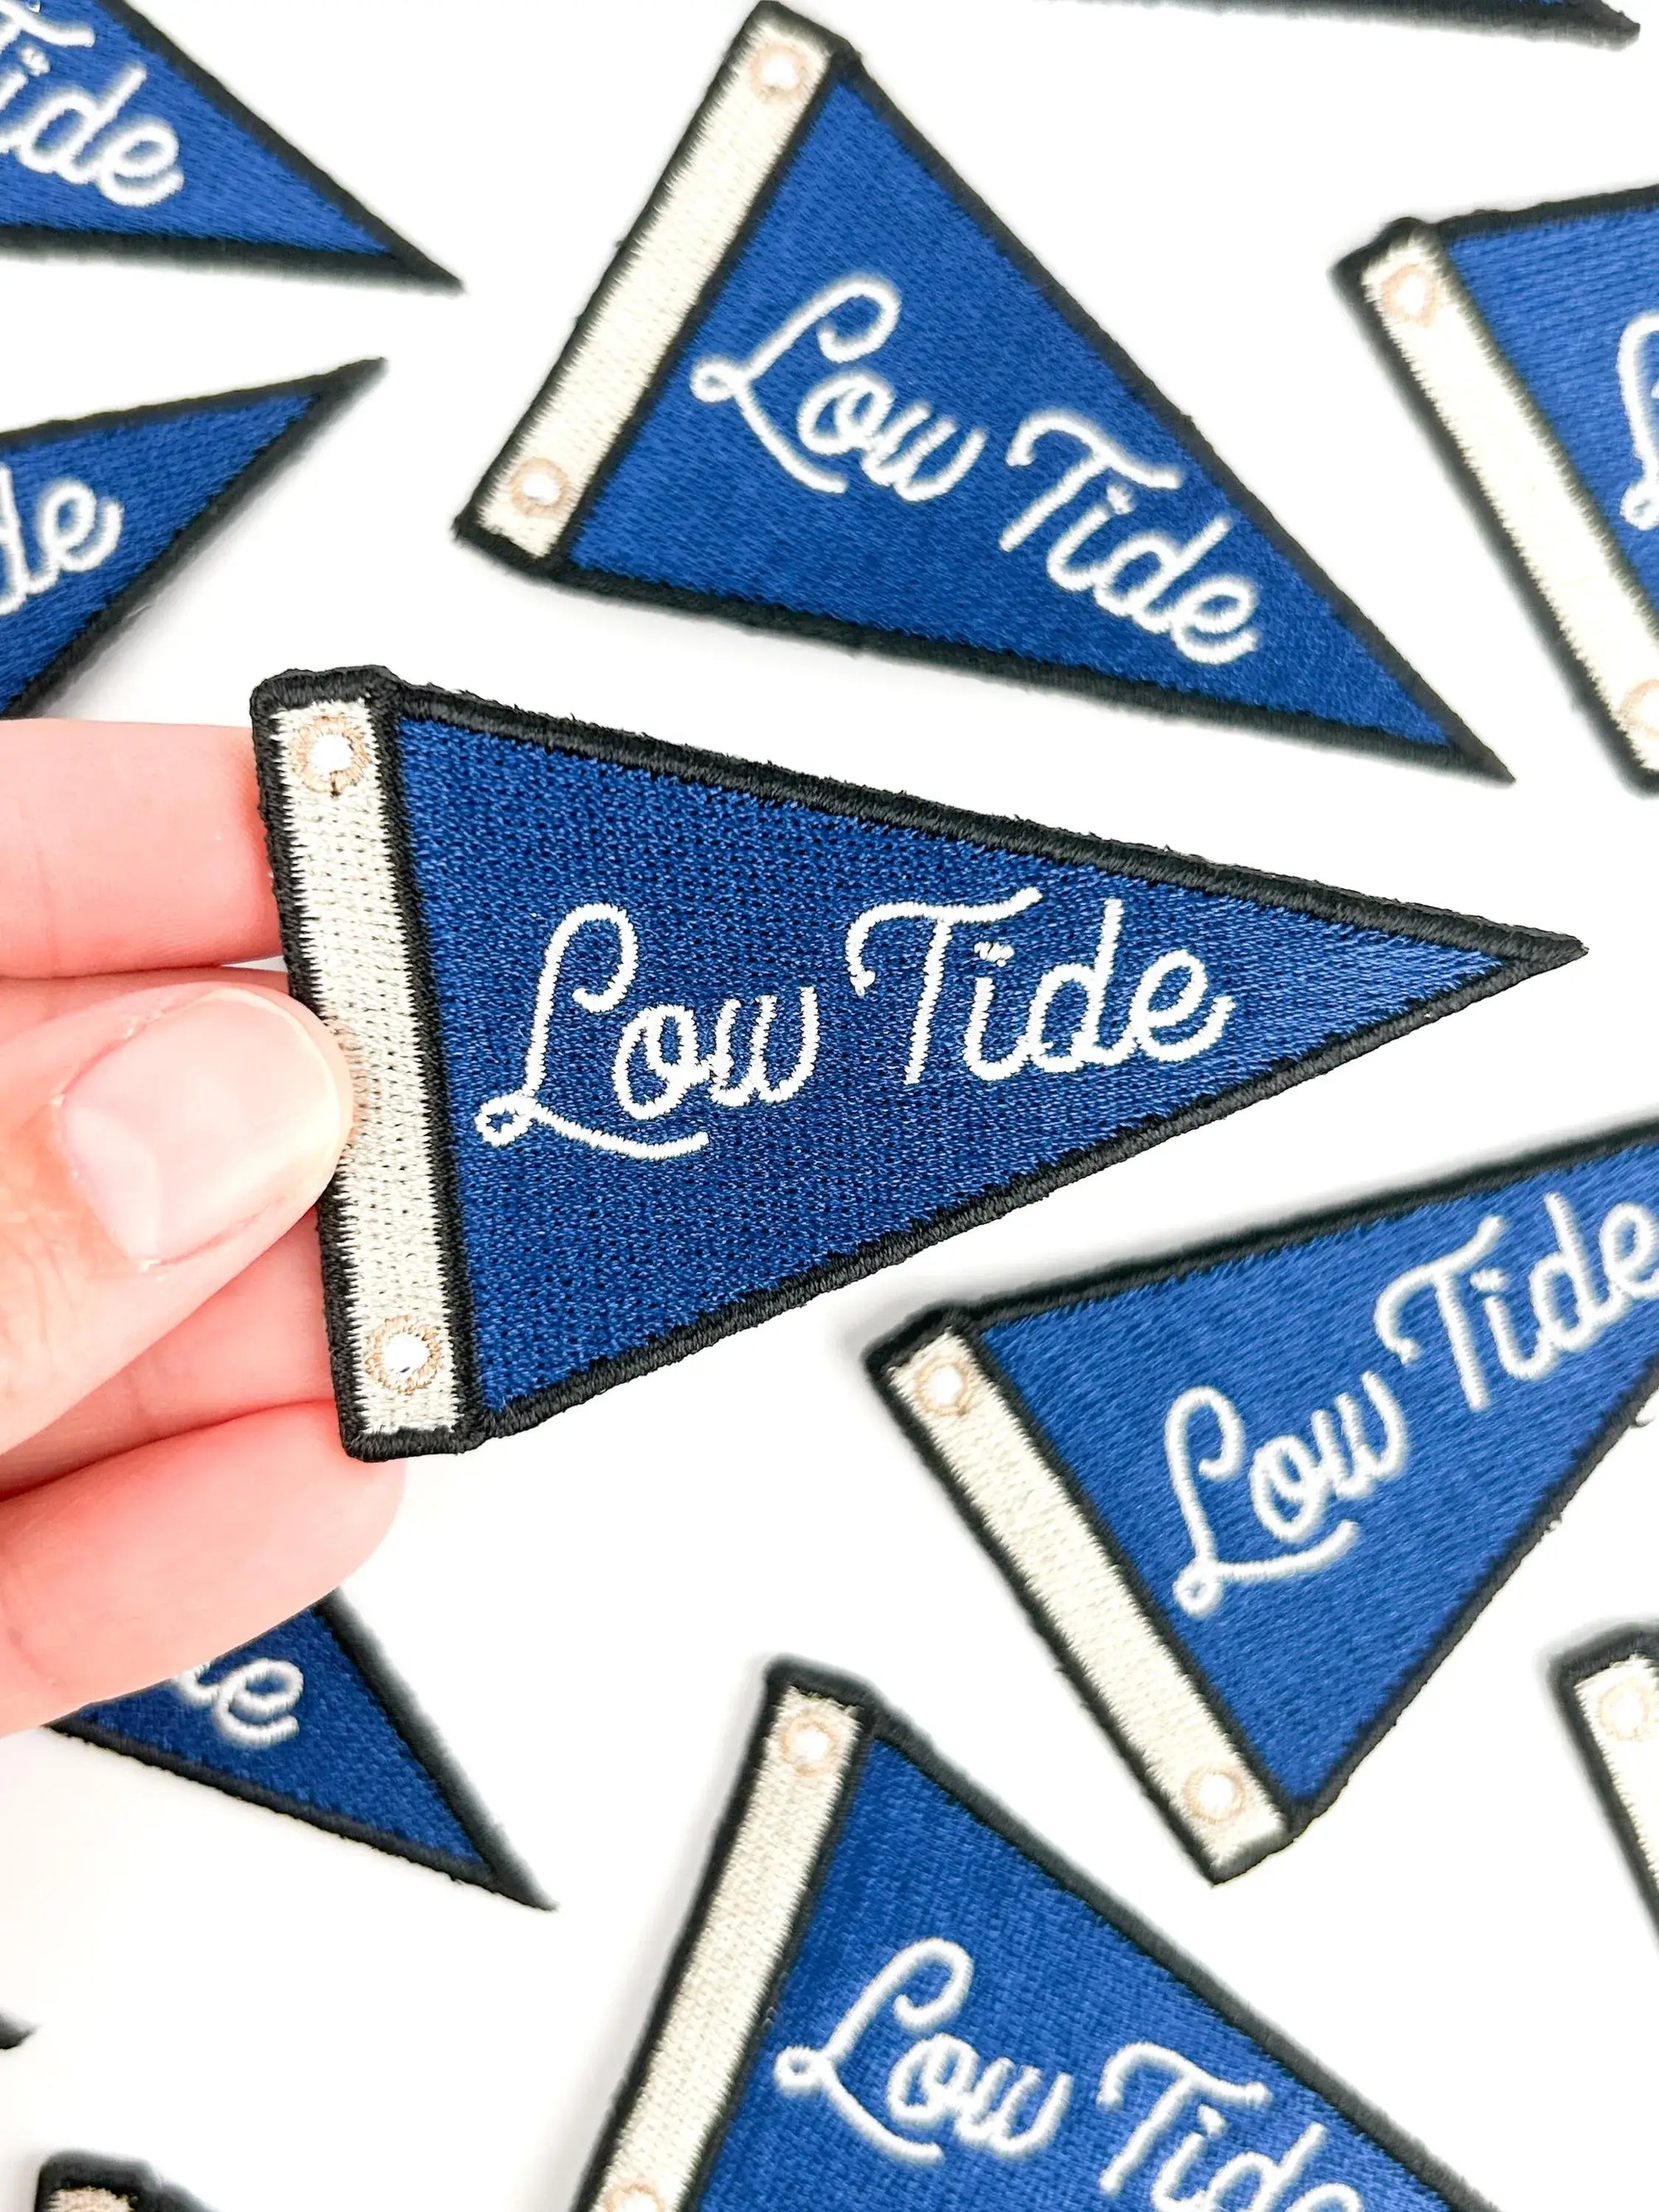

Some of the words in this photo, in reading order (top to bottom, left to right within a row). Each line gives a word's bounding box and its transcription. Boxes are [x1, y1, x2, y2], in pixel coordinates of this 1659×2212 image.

[690, 275, 988, 502] Low
[1000, 410, 1258, 664] Tide
[474, 902, 820, 1159] Low
[845, 887, 1235, 1086] Tide
[1164, 1385, 1408, 1619] Low
[1374, 1192, 1659, 1410] Tide
[773, 1937, 1073, 2164] Low
